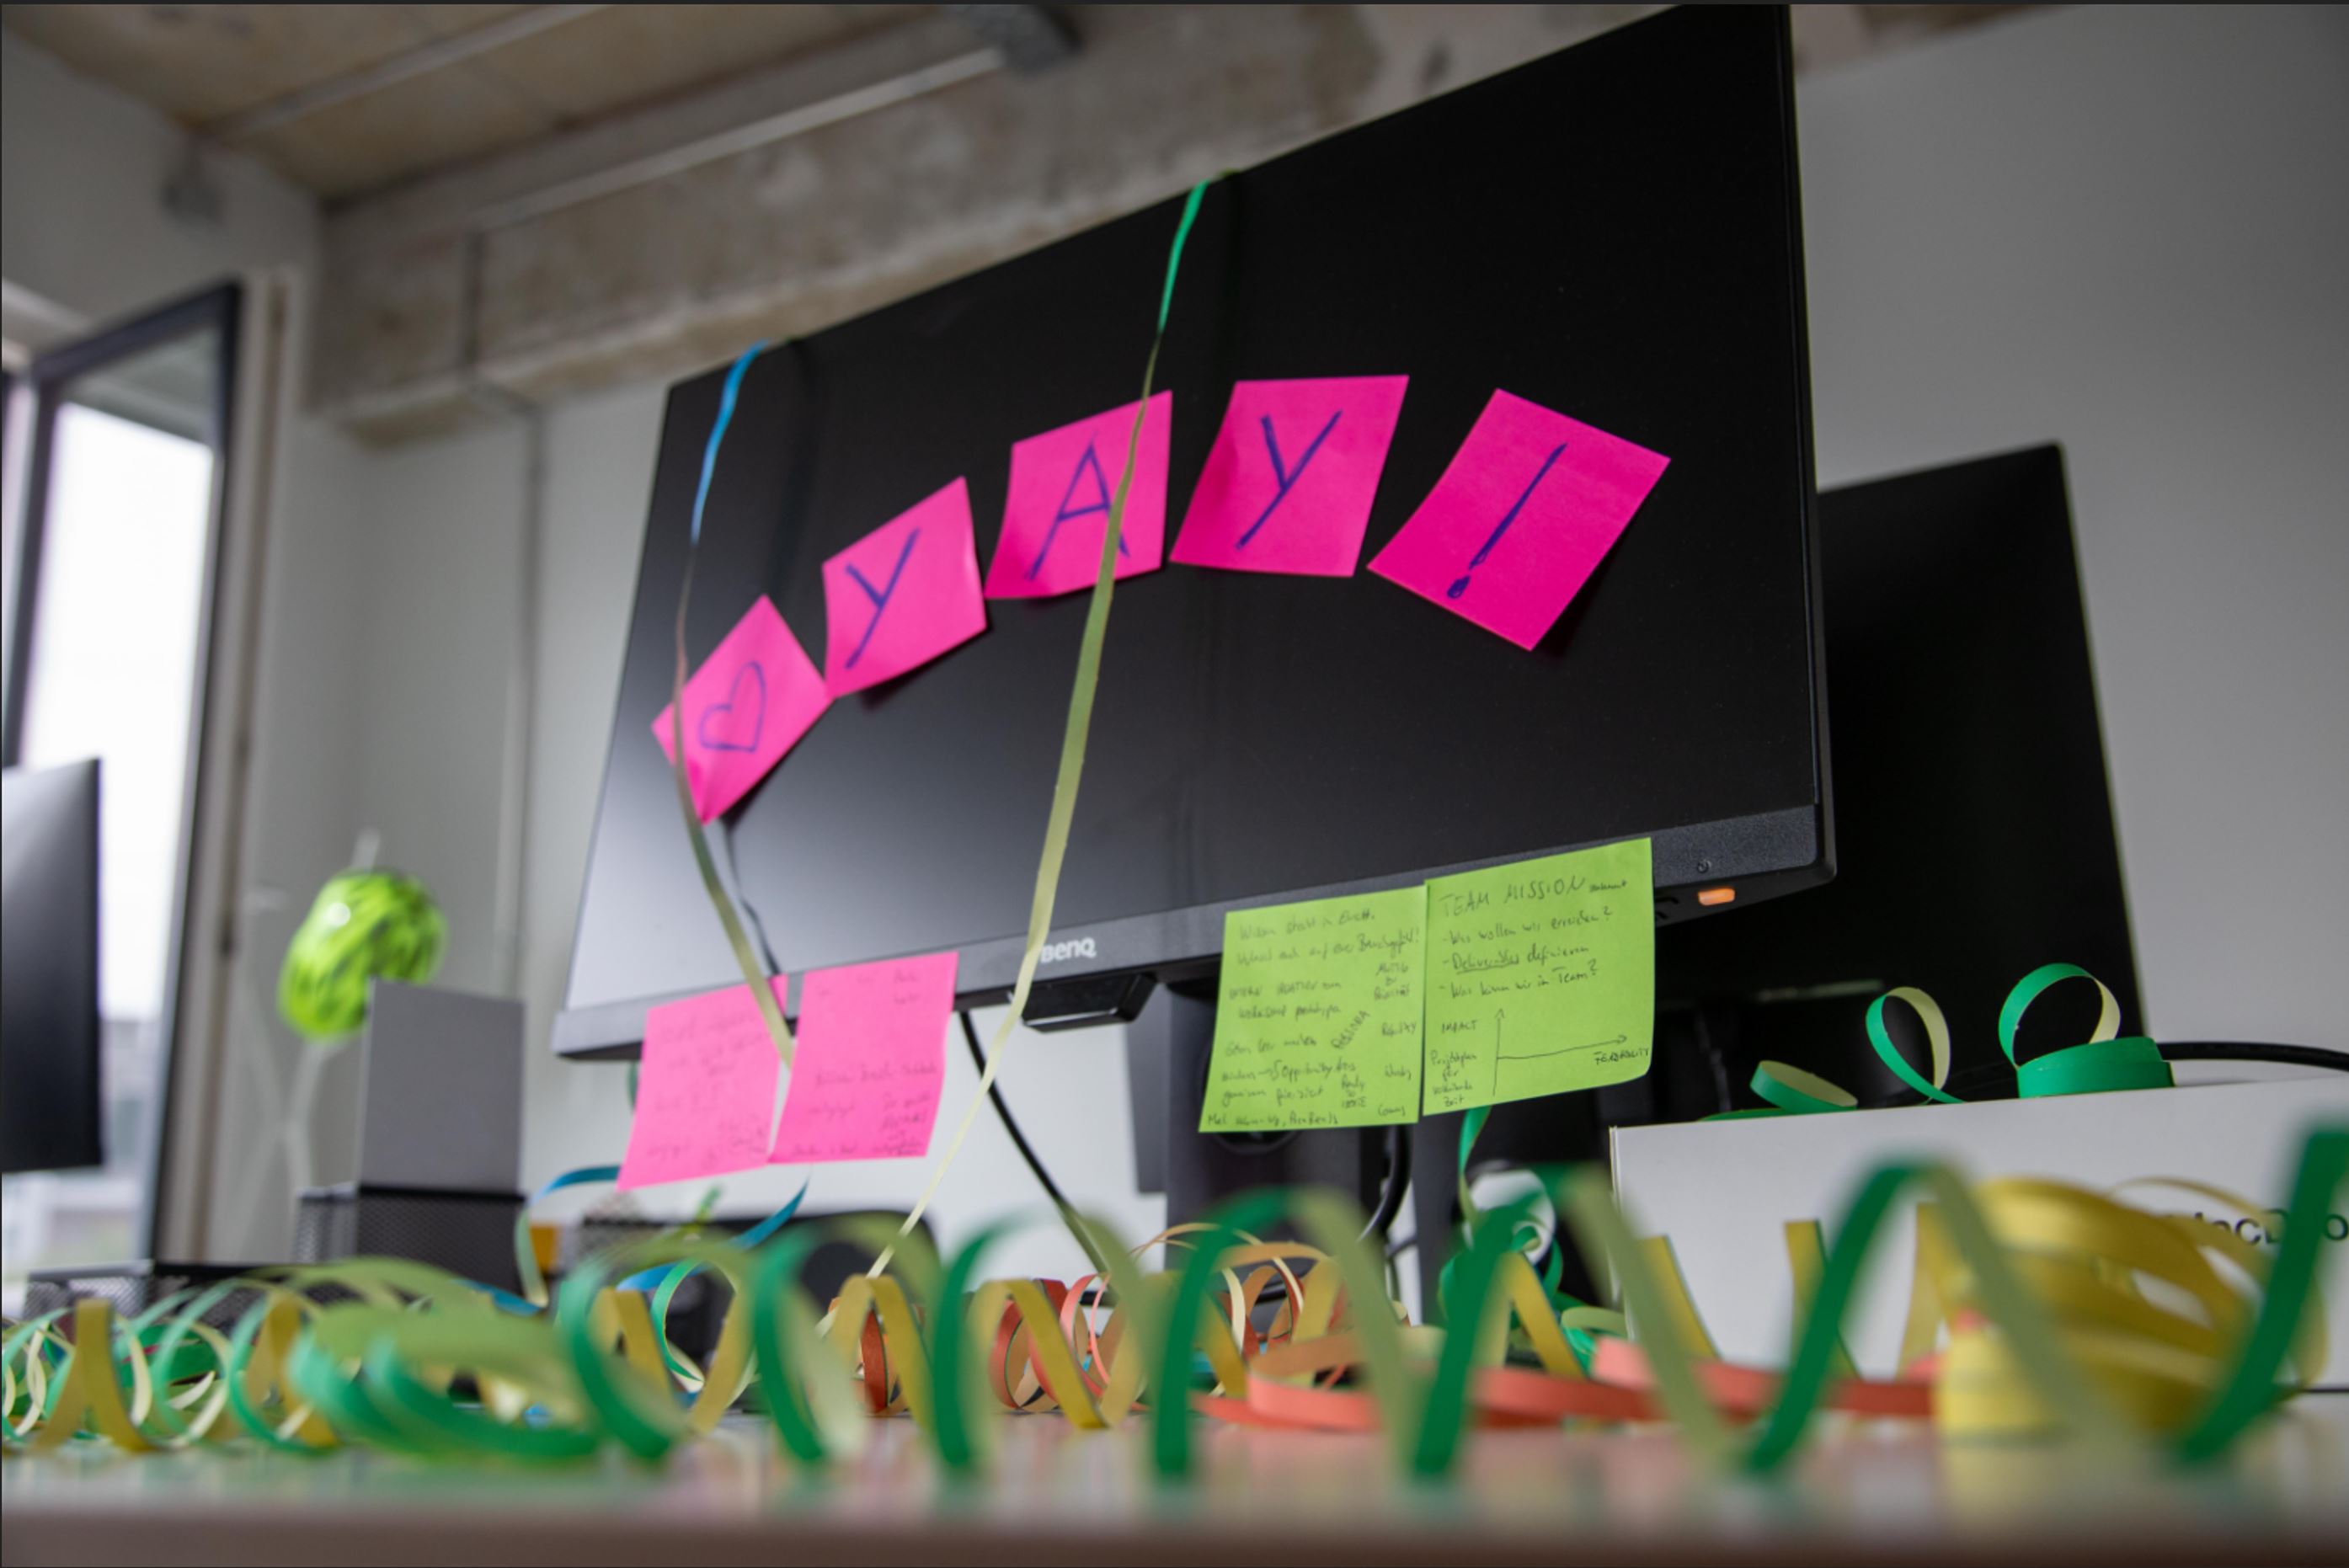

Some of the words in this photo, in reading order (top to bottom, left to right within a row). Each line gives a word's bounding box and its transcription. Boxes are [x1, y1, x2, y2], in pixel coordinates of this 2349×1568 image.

[1438, 890, 1490, 917] TEAM
[1503, 874, 1586, 904] MISSION
[1478, 922, 1516, 941] wollen
[1522, 922, 1541, 932] wir
[1527, 942, 1589, 966] definieren
